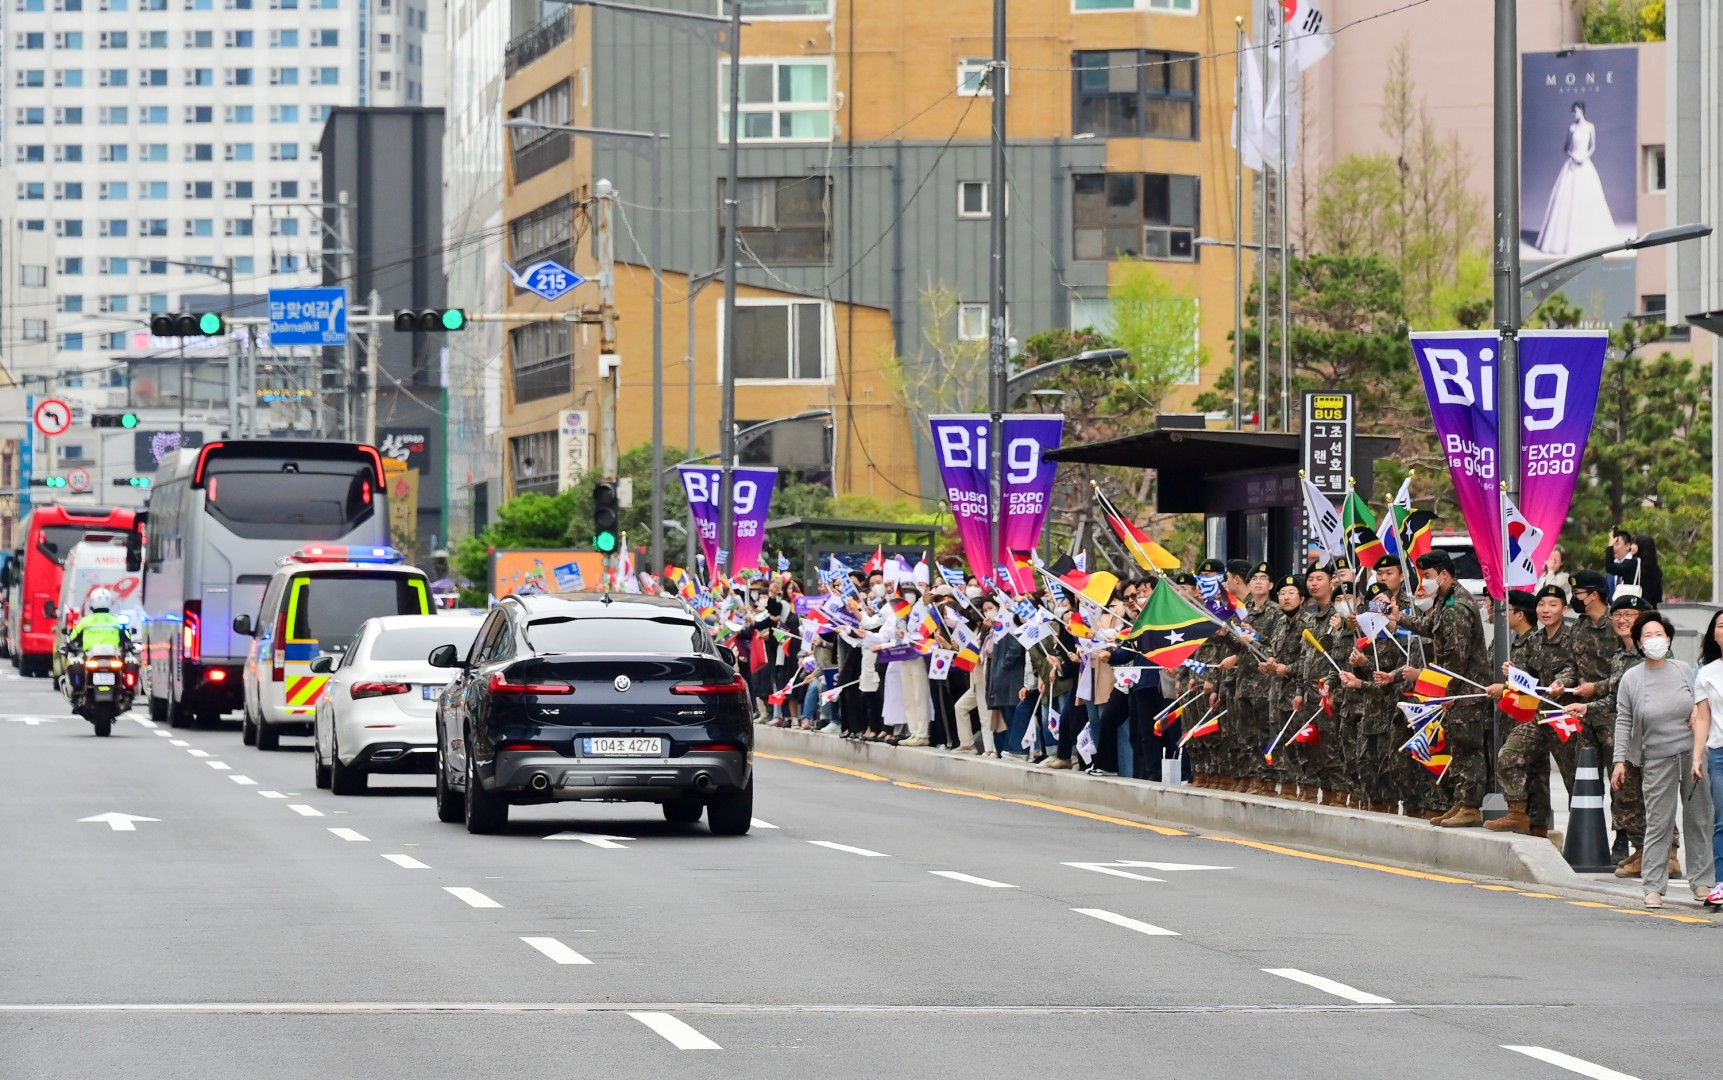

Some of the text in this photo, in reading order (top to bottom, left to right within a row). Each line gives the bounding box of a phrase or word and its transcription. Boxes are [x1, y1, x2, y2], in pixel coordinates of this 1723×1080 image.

[1545, 71, 1613, 86] MONE
[536, 273, 567, 290] 215
[271, 301, 330, 319] 달맞이길
[322, 332, 346, 341] 150m
[1314, 409, 1343, 420] BUS
[1313, 425, 1328, 488] 그랜드
[1328, 425, 1343, 490] 조선호텔
[1528, 442, 1577, 461] EXPO
[1448, 456, 1462, 468] is
[1527, 459, 1575, 477] 2030
[1010, 492, 1044, 504] EXPO
[1008, 503, 1043, 515] 2030
[594, 739, 659, 752] 104조 4276
